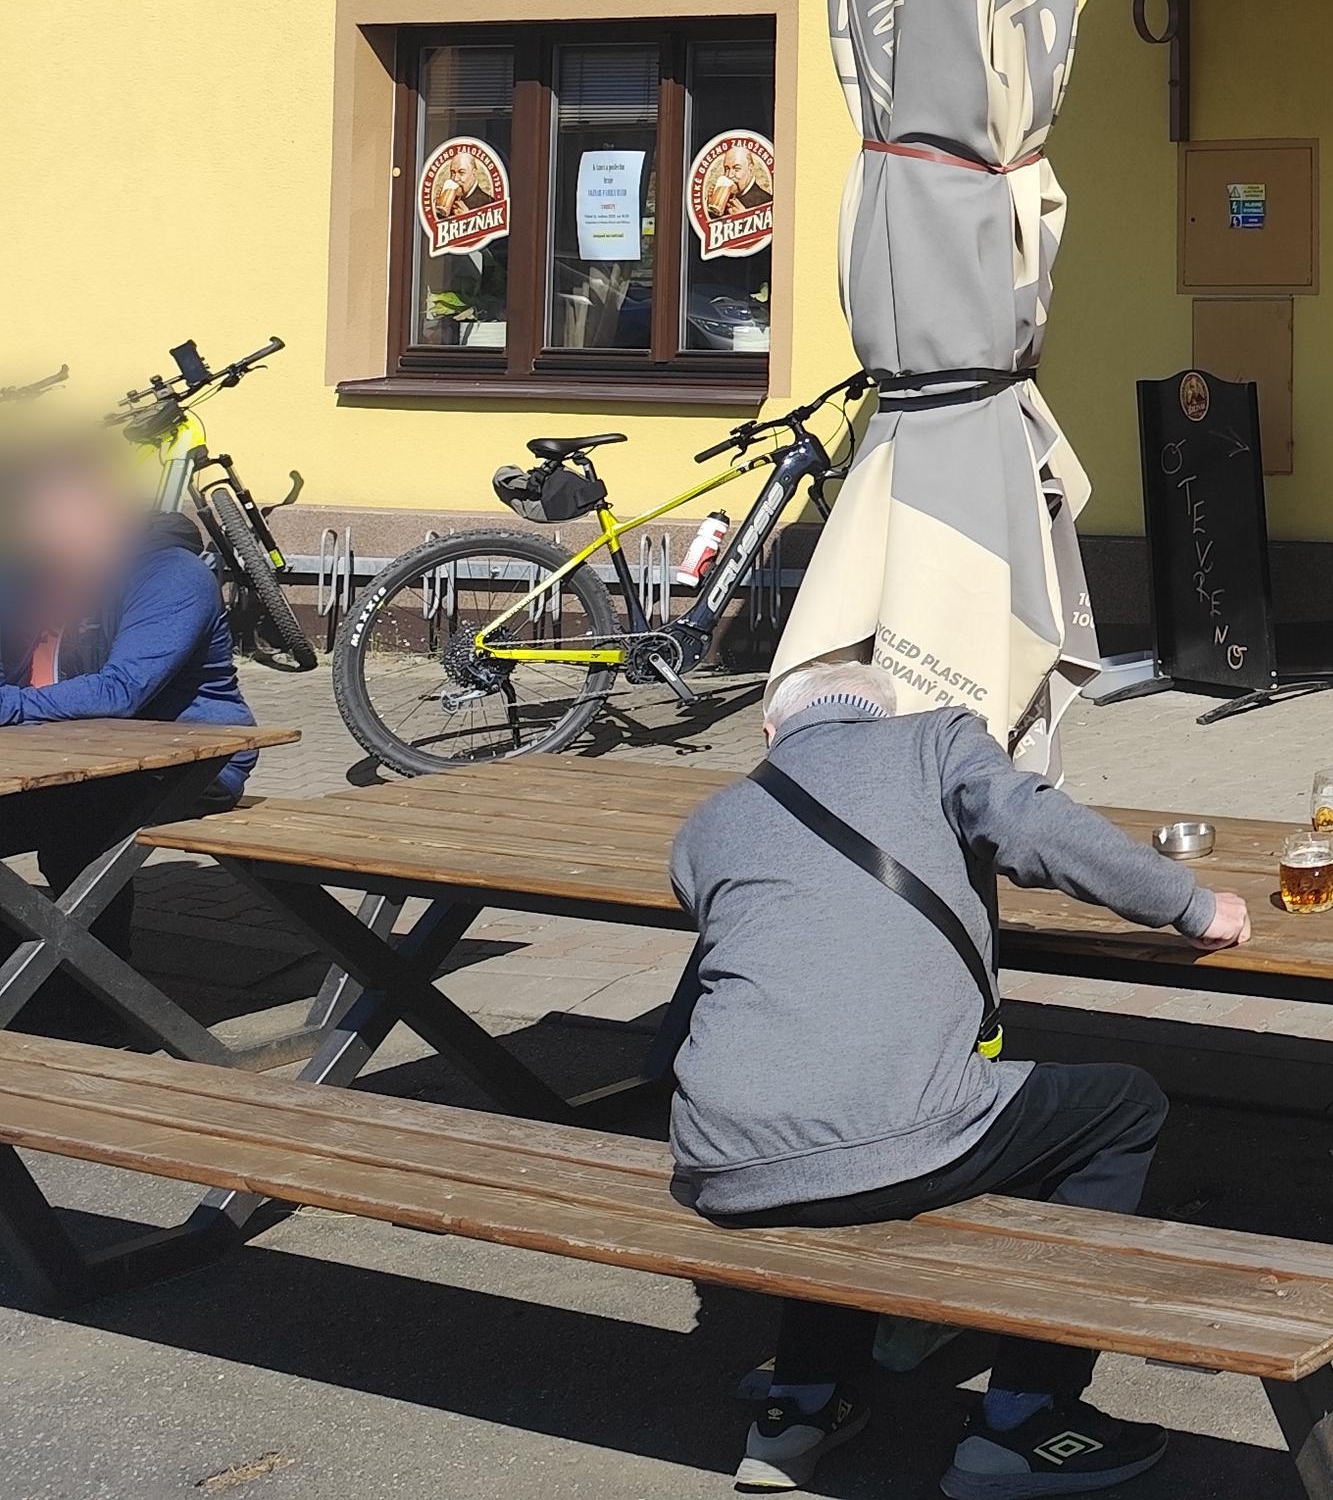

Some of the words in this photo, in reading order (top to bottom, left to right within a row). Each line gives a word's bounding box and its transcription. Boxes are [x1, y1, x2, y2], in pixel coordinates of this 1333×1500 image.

[435, 207, 504, 248] BŘEZŇÁK
[351, 587, 386, 647] MAXXIS
[920, 653, 988, 702] PLASTIC
